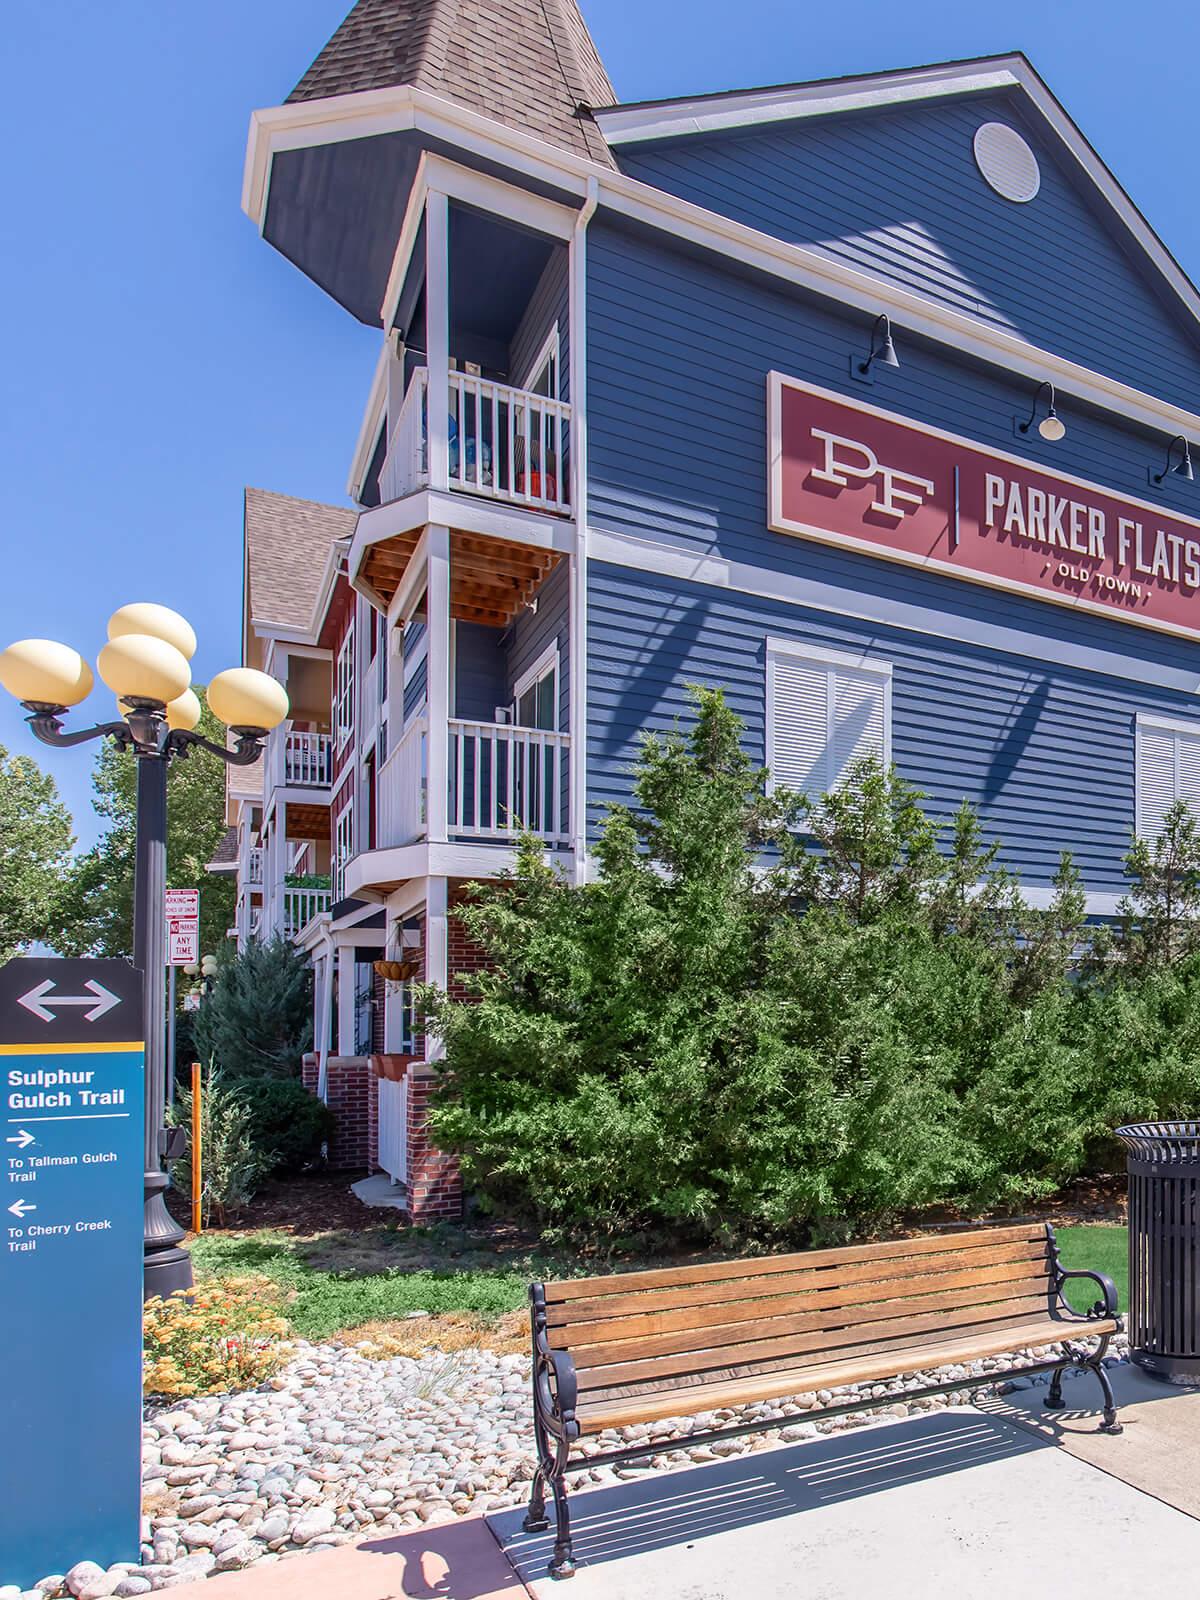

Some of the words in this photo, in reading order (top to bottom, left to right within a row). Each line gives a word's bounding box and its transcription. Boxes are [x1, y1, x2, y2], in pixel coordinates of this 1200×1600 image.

[811, 427, 935, 518] PF
[985, 472, 1106, 560] PARKER
[1117, 516, 1200, 589] FLATS
[1058, 563, 1090, 582] OLD
[1096, 574, 1142, 597] TOWN
[177, 937, 191, 945] ANY
[176, 947, 192, 955] TIME
[8, 1069, 95, 1088] Sulphur
[8, 1092, 72, 1109] Gulch
[78, 1089, 125, 1106] Trail
[8, 1158, 23, 1168] To
[28, 1155, 78, 1167] Tallman
[82, 1152, 117, 1164] Gulch
[8, 1171, 36, 1182] Trail
[8, 1228, 23, 1238] To
[28, 1224, 71, 1237] Cherry
[75, 1219, 112, 1231] Creek
[8, 1240, 36, 1252] Trail
